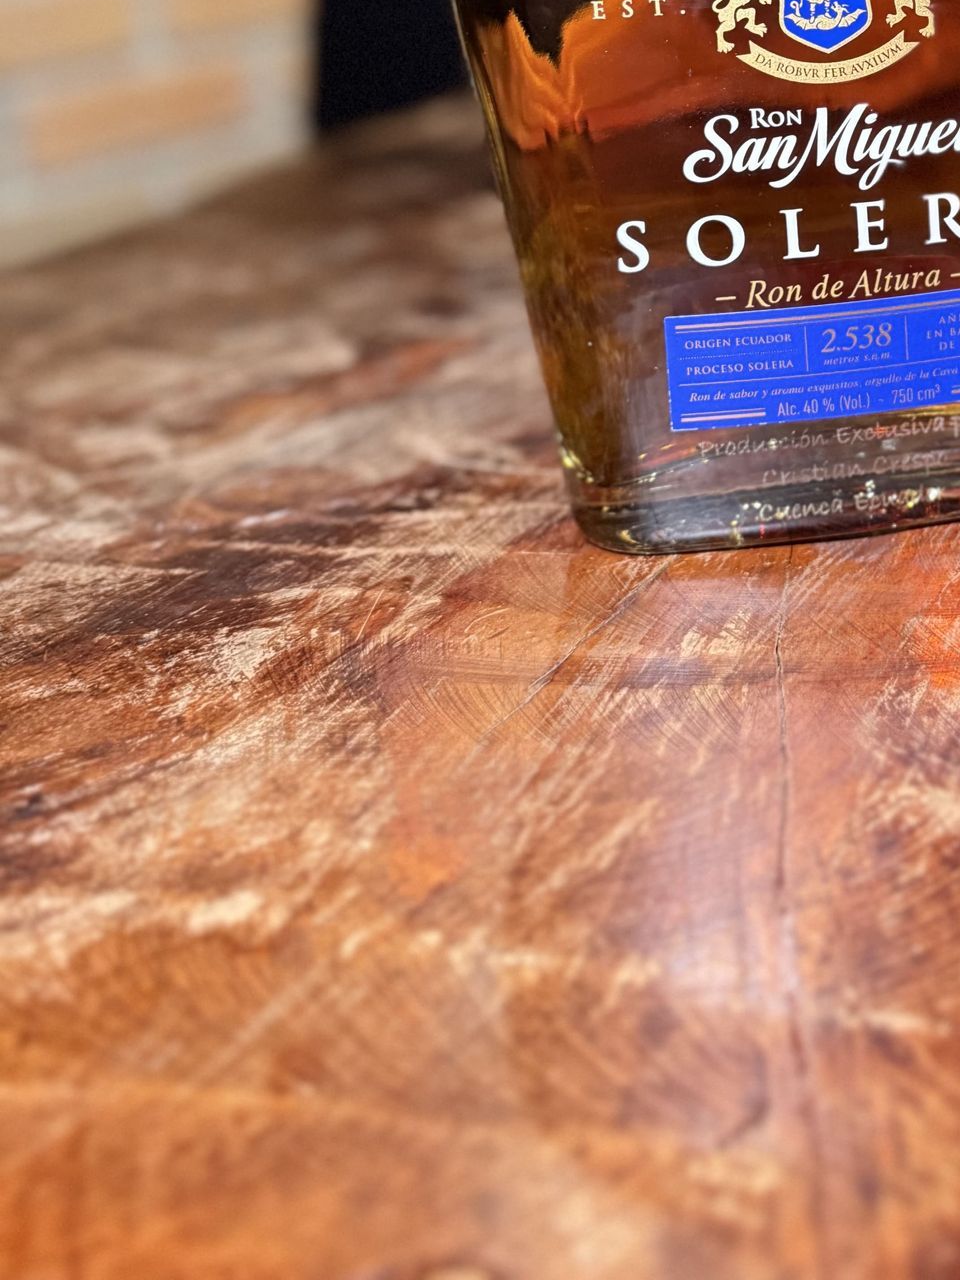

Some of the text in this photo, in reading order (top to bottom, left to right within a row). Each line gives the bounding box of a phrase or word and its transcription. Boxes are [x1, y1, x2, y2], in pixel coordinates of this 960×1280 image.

[754, 52, 772, 69] DA
[776, 63, 820, 79] ROBVR
[824, 66, 847, 79] FER
[682, 114, 798, 183] San
[744, 264, 941, 309] Ron de Altura
[684, 333, 792, 350] ORIGEN ECUADOR
[821, 322, 892, 354] 2.538
[926, 329, 943, 340] EN
[939, 341, 955, 351] DE
[686, 359, 794, 376] PROCESO SOLERA
[689, 392, 711, 402] Ron
[713, 390, 727, 400] de
[729, 389, 759, 400] sabor
[761, 389, 769, 400] y
[771, 385, 804, 396] aroma
[865, 373, 902, 388] orgullo
[904, 371, 918, 382] de
[919, 367, 930, 378] la
[932, 366, 958, 378] Cava
[777, 403, 800, 417] Alc.
[803, 399, 819, 413] 40
[822, 398, 835, 412] %
[839, 393, 870, 412] (Vol.)
[891, 388, 914, 404] 750
